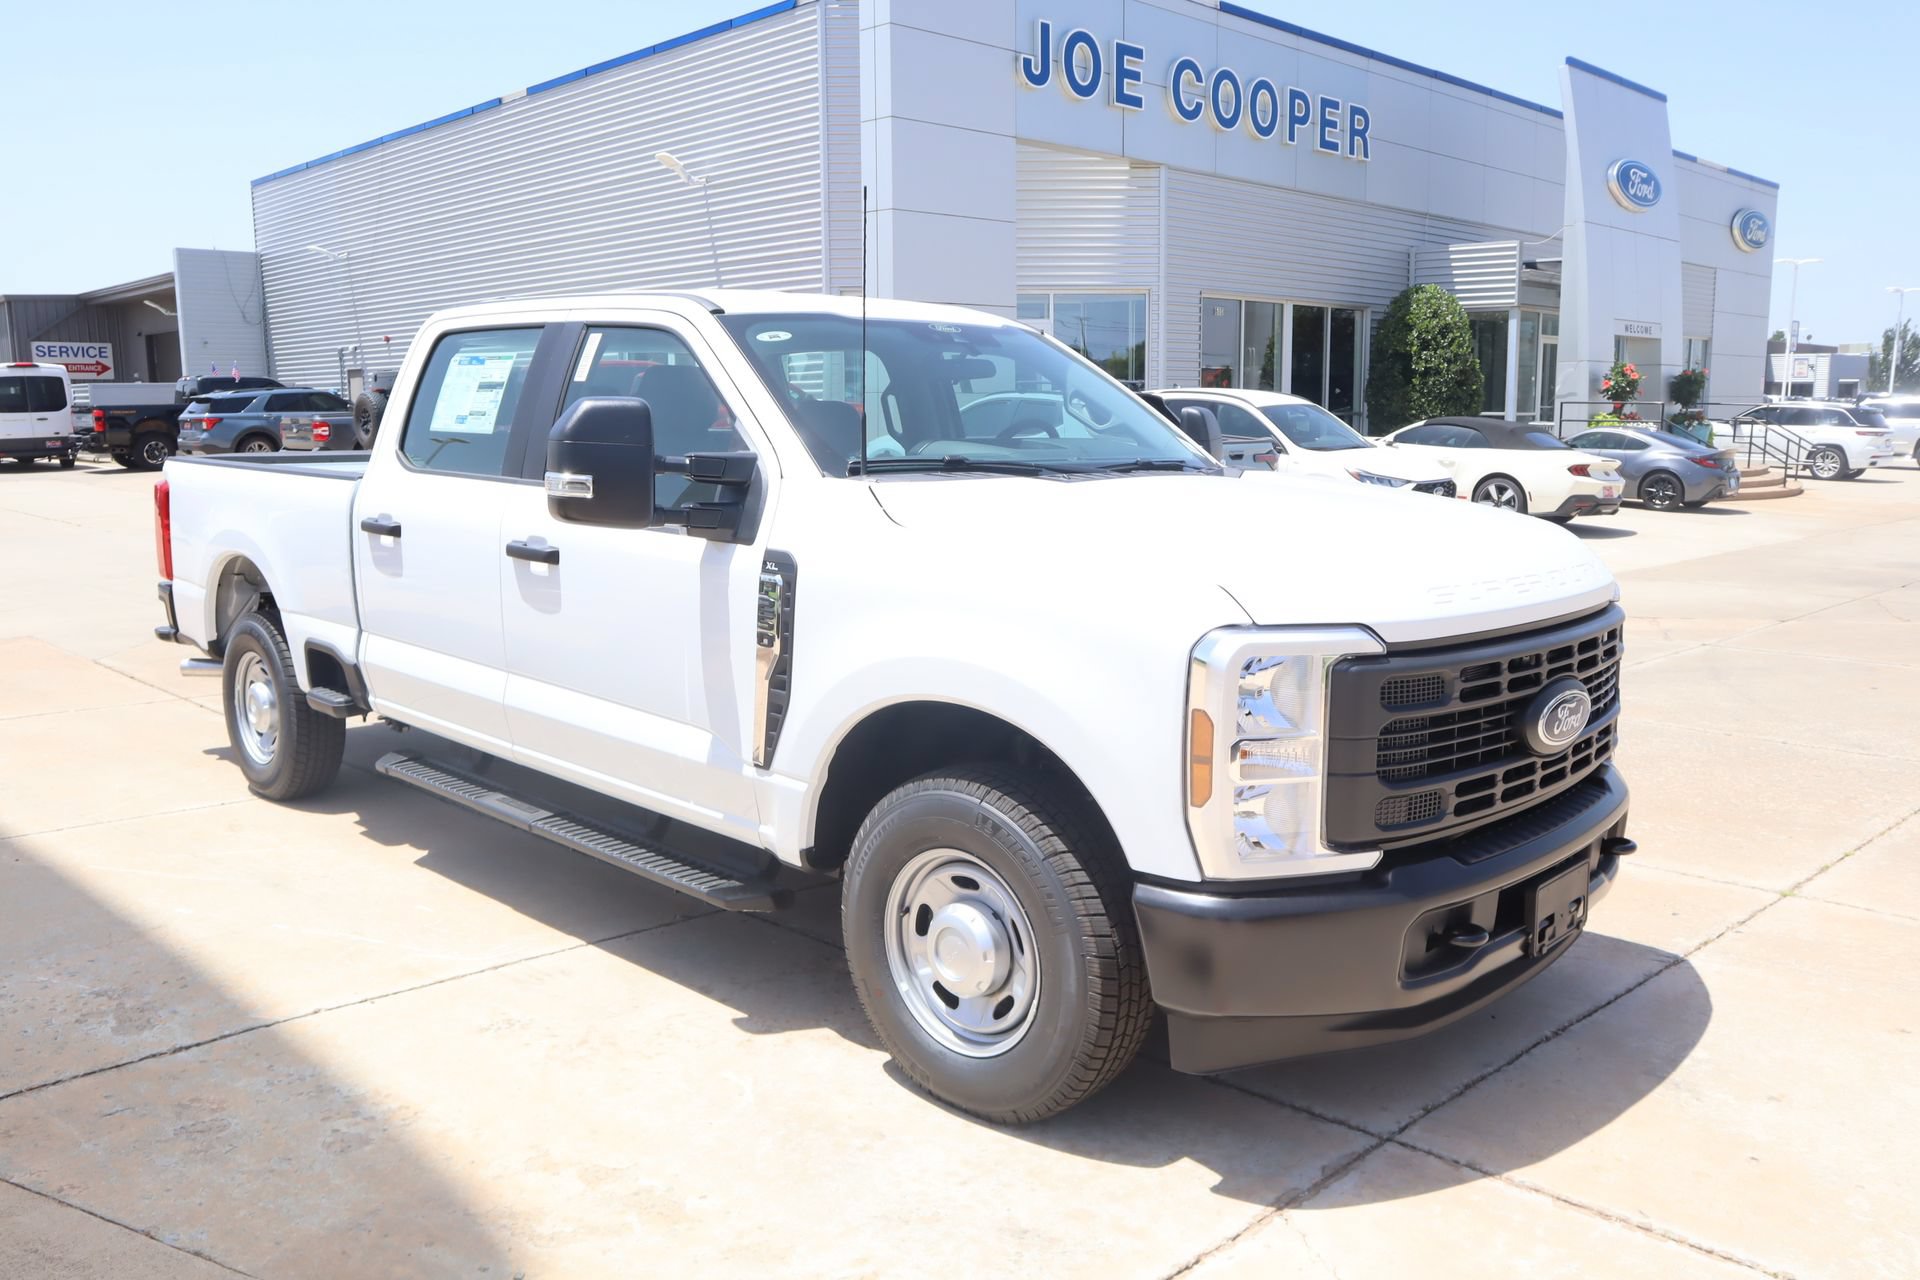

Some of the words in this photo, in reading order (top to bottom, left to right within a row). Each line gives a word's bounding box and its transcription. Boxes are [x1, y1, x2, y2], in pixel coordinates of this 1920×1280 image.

[1018, 20, 1145, 110] JOE
[1167, 57, 1371, 160] COOPER
[1628, 168, 1655, 200] Ford
[1746, 218, 1768, 242] Ford
[1624, 323, 1653, 336] WELCOME
[35, 344, 109, 359] SERVICE
[67, 364, 103, 372] ENTRANCE
[765, 561, 779, 571] XL
[1553, 701, 1583, 735] Ford
